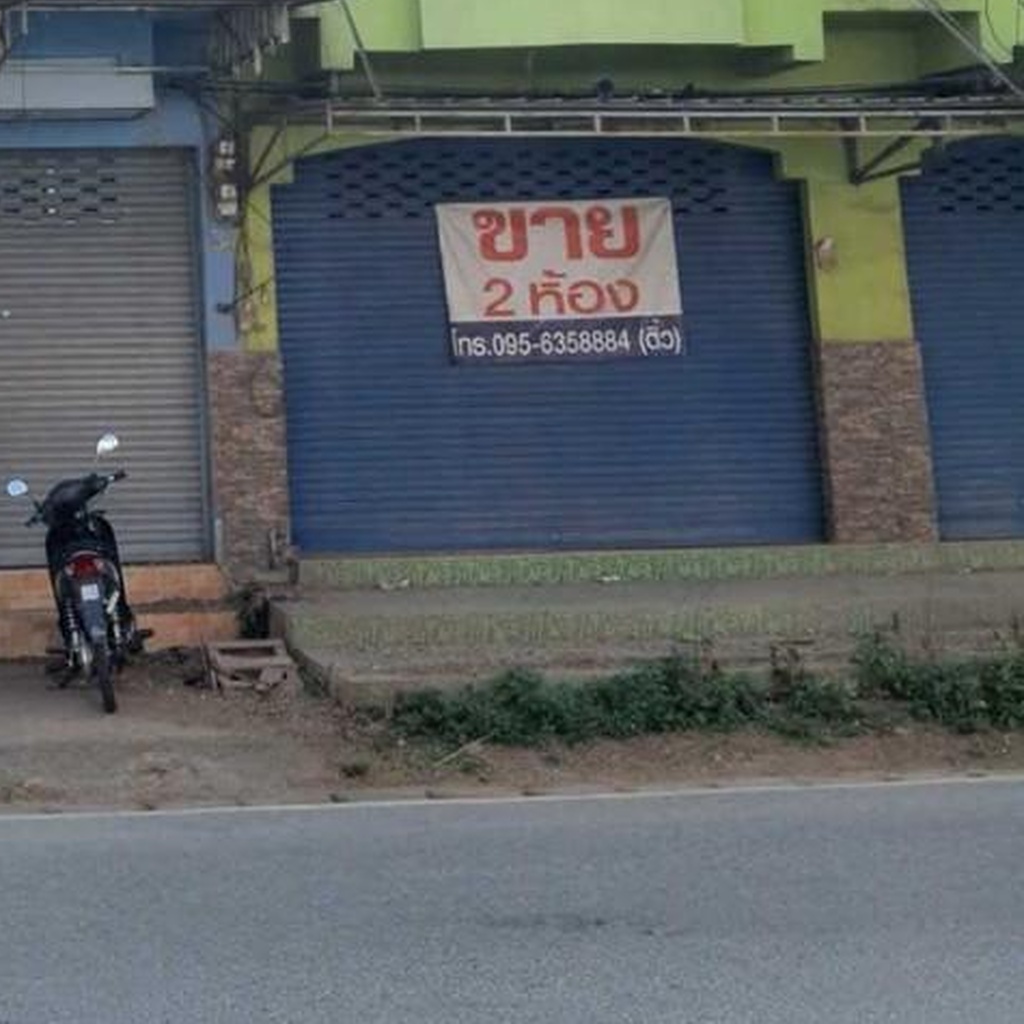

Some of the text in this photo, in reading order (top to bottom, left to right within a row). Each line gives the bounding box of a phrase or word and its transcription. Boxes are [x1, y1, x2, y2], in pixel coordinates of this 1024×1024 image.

[472, 204, 641, 263] ขาย
[483, 269, 640, 317] 2 ห้อง
